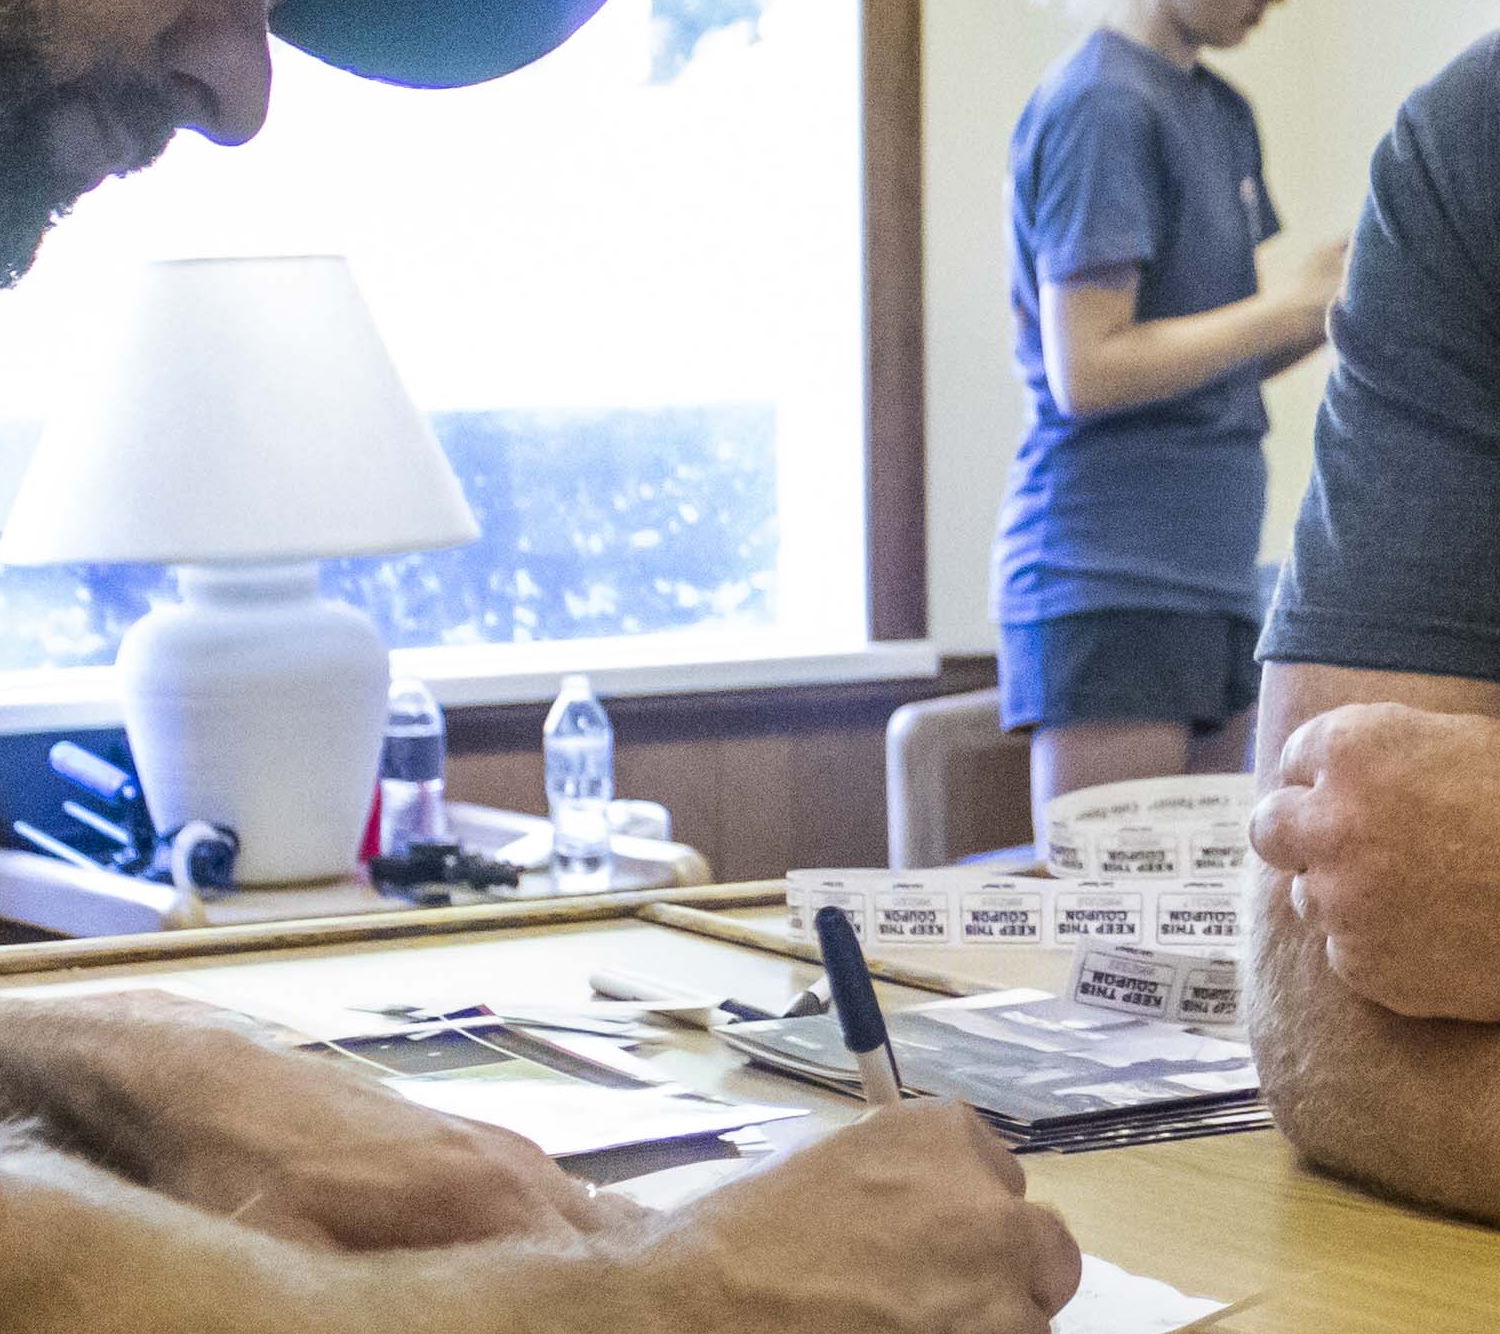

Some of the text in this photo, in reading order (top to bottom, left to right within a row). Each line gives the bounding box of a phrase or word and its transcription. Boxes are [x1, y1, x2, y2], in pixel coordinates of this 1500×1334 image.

[884, 910, 937, 923] COUPON
[971, 910, 1029, 923] COUPON
[1065, 910, 1128, 922] COUPON
[1058, 923, 1135, 935] KEEP THIS
[1161, 923, 1196, 935] THIS
[1092, 971, 1158, 994] COUPON
[1079, 982, 1163, 1008] KEEP THIS
